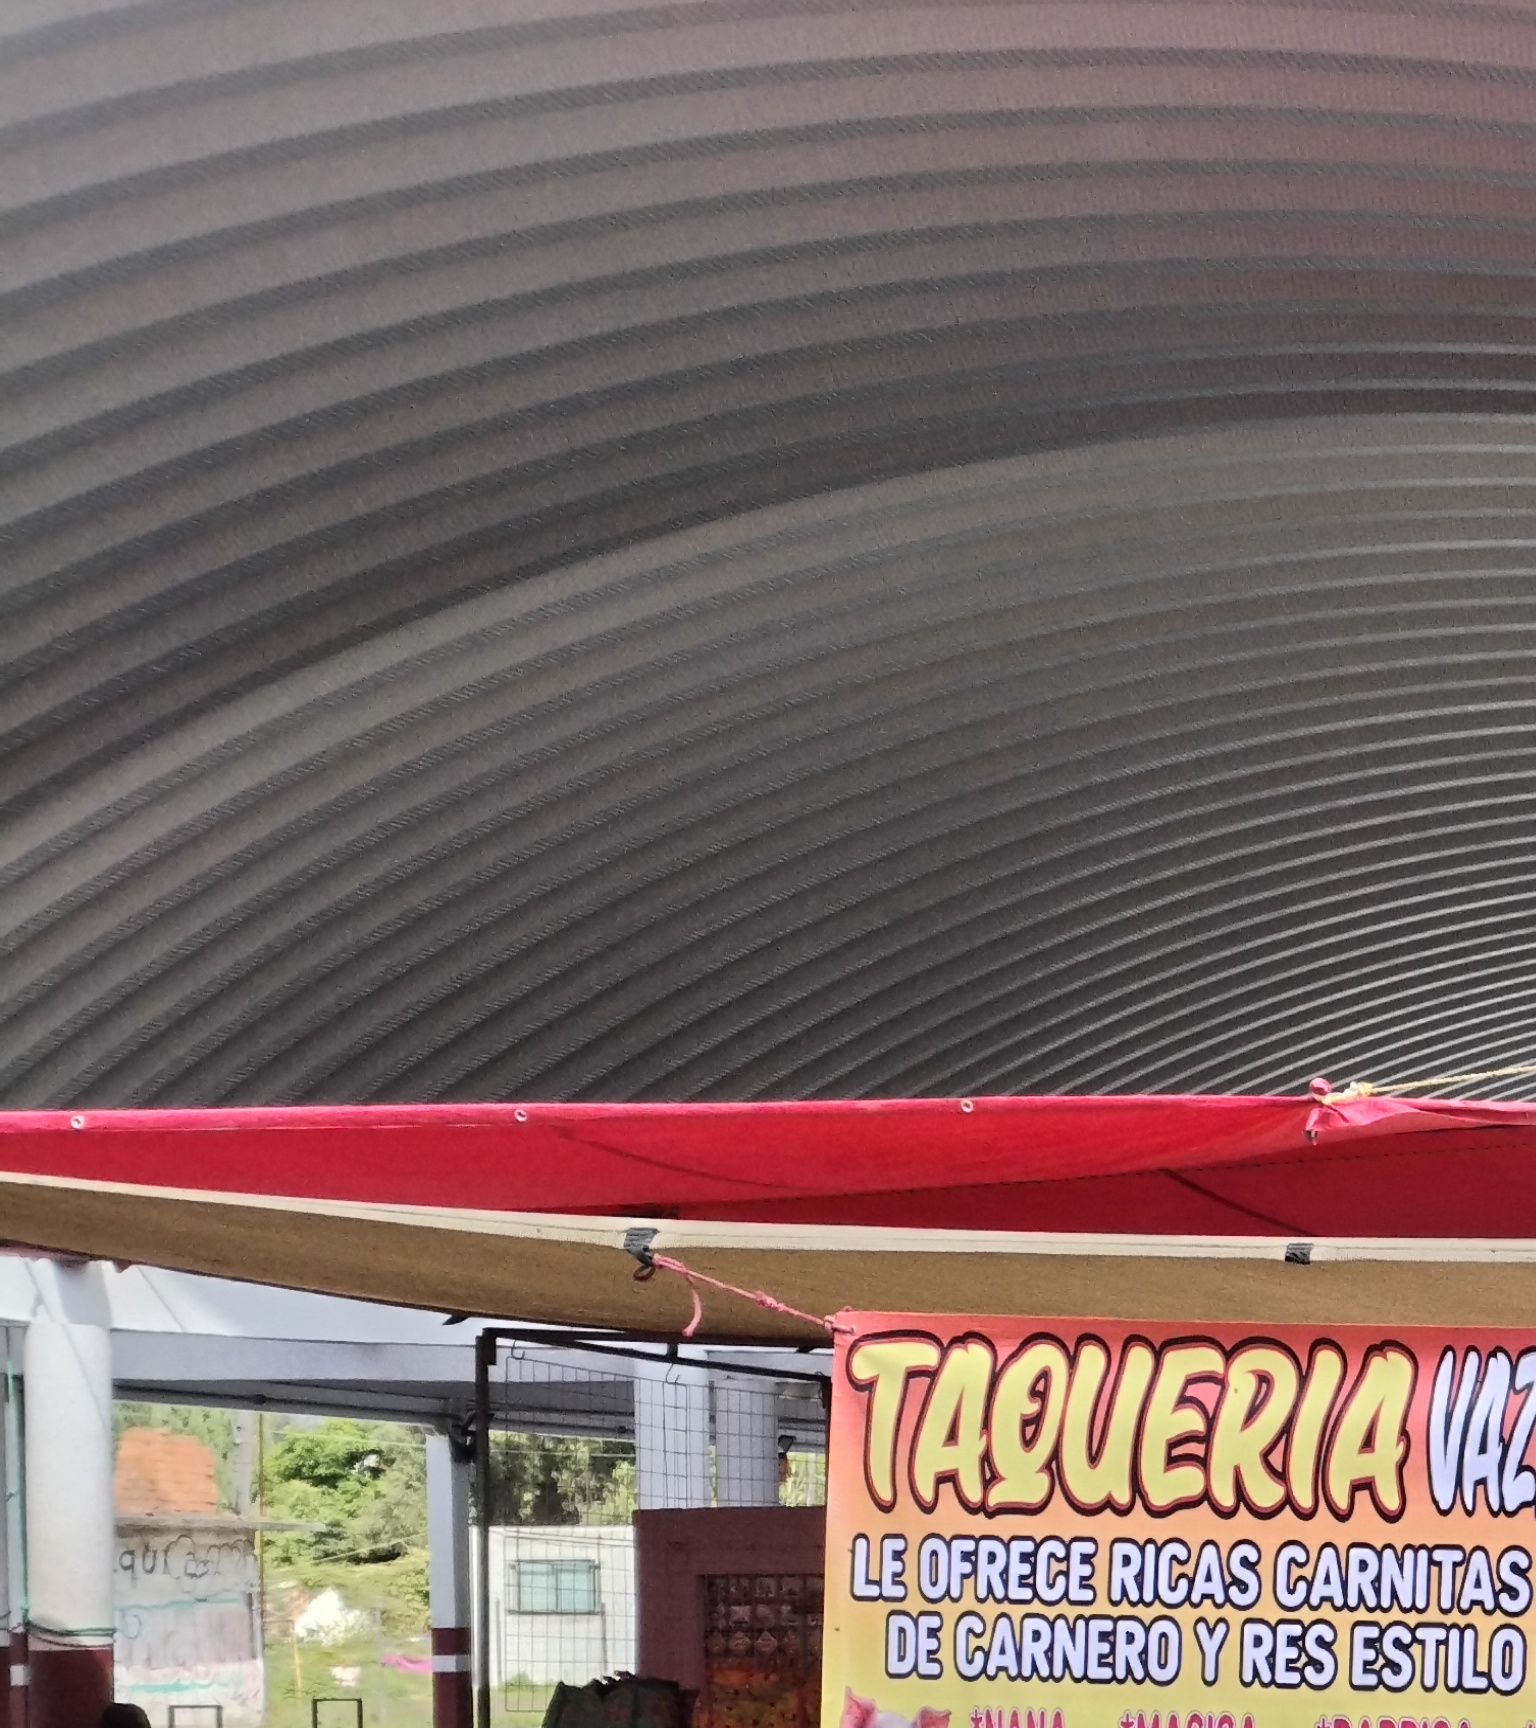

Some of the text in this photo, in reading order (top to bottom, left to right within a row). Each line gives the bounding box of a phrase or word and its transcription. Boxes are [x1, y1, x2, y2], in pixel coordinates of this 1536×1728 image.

[846, 1329, 1420, 1523] TAQUERIA
[851, 1533, 908, 1603] LE
[918, 1535, 1099, 1605] OFRECE
[1109, 1537, 1262, 1611] RICAS
[1275, 1540, 1533, 1618] CARNITAS
[886, 1610, 944, 1680] DE
[953, 1611, 1182, 1684] CARNERO
[1193, 1615, 1230, 1686] Y
[1240, 1618, 1338, 1691] RES
[1349, 1620, 1529, 1697] ESTILO
